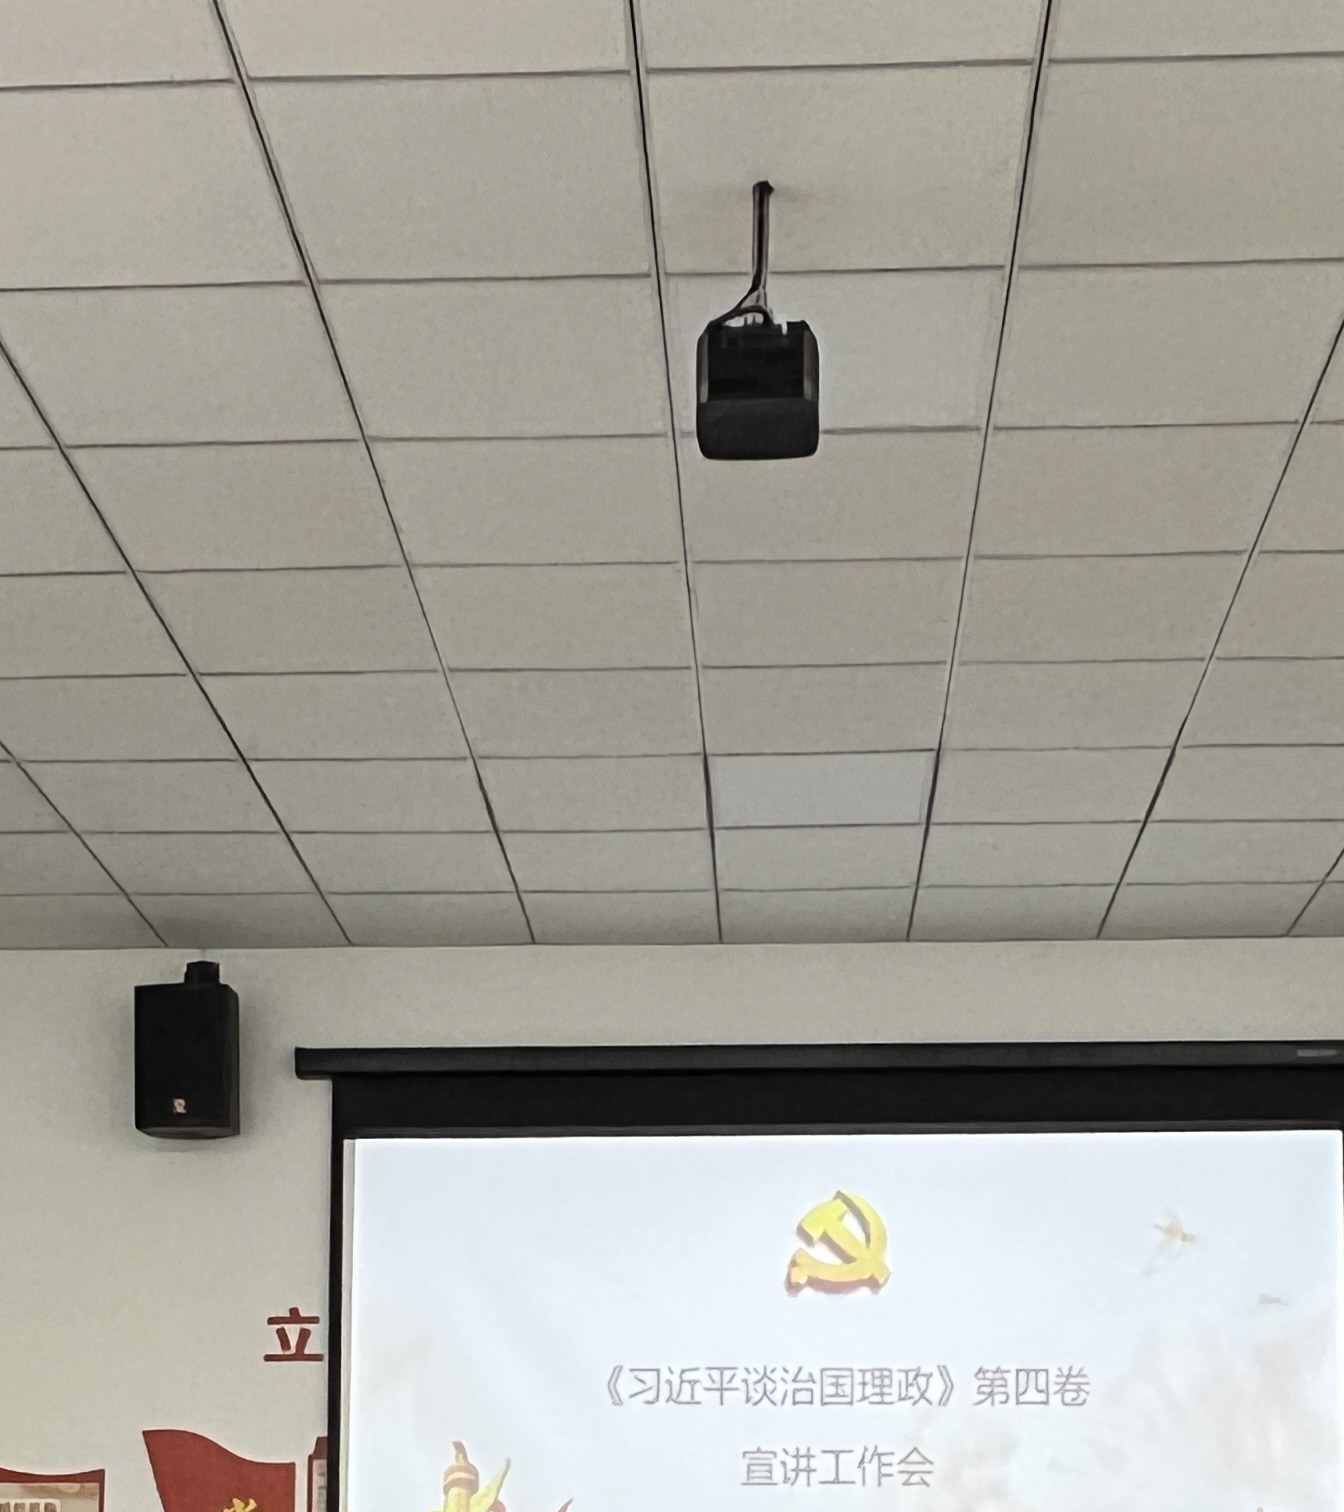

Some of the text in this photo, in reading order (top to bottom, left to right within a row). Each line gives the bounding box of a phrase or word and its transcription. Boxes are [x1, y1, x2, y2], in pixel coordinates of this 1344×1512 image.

[263, 1306, 325, 1362] 立
[607, 1364, 1091, 1407] 《习近平谈治国理政》第四卷
[740, 1445, 935, 1488] 宣讲工作会
